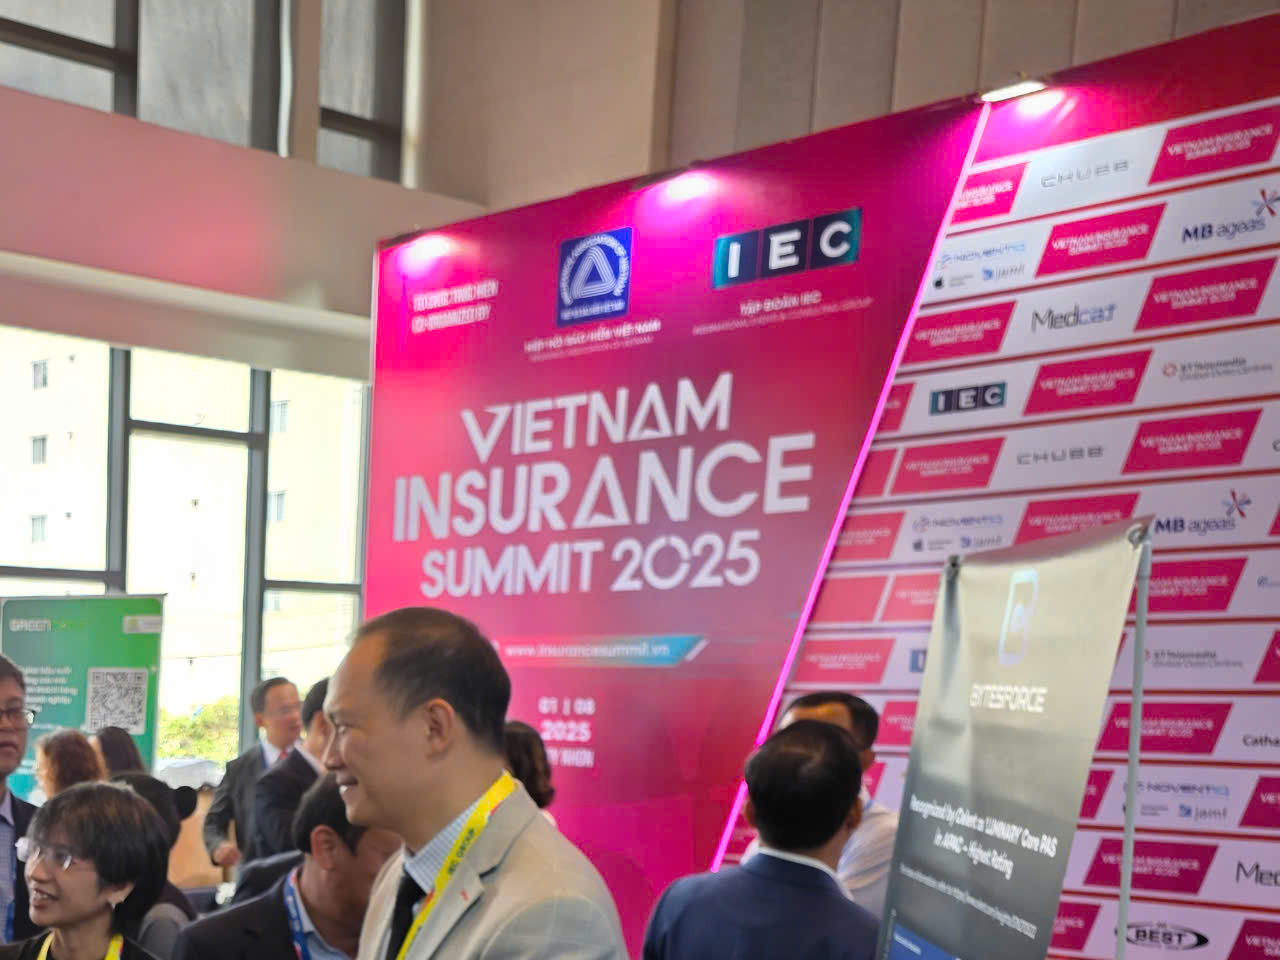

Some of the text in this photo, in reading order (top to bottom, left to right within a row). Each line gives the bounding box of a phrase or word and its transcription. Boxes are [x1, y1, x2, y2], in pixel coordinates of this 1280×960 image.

[1041, 160, 1129, 188] CHUBB
[1182, 218, 1265, 243] MB ageas
[727, 220, 852, 278] IEC
[1032, 303, 1117, 333] Medcat
[937, 386, 1002, 412] IEC
[462, 373, 733, 463] VIETNAM
[1017, 445, 1103, 465] CHUBB
[393, 432, 816, 542] INSURANCE
[1155, 518, 1235, 536] MB ageas
[421, 530, 760, 598] SUMMIT 2025
[541, 720, 591, 742] 2025
[1135, 928, 1184, 945] BEST
